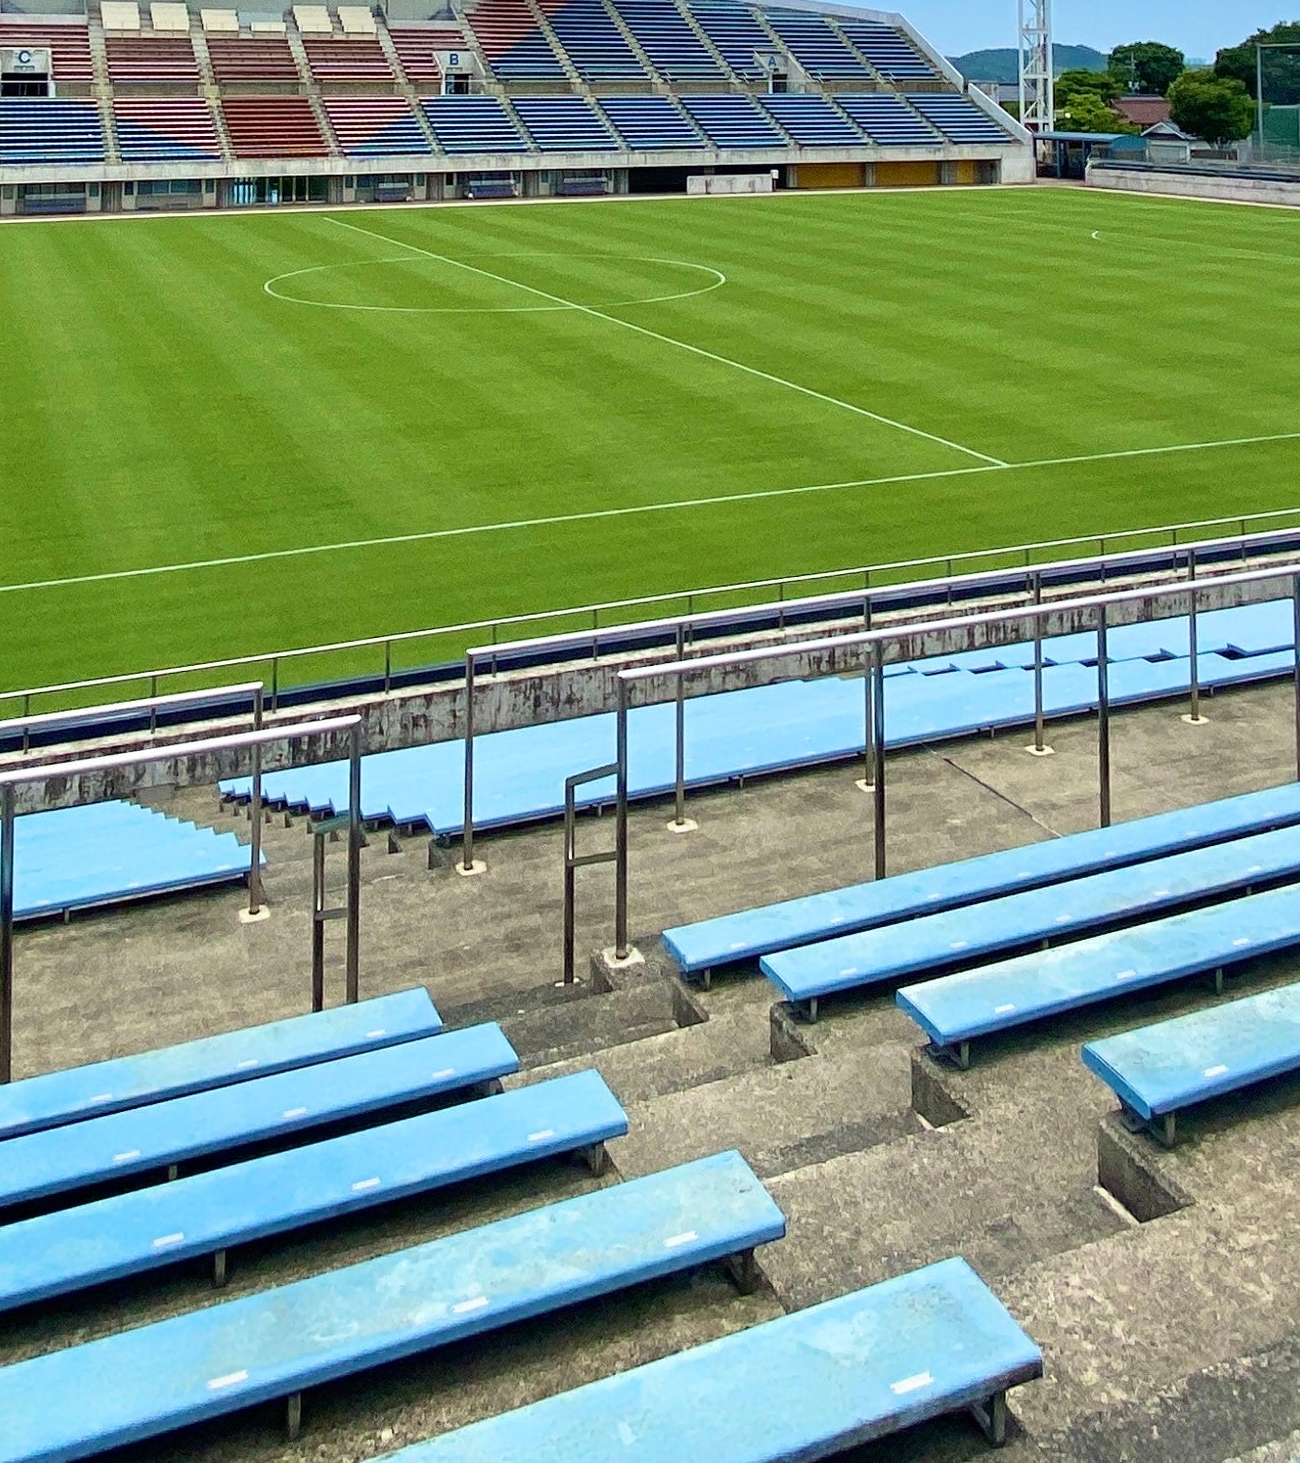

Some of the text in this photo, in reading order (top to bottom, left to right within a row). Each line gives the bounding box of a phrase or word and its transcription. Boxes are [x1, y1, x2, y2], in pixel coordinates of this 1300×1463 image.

[19, 50, 31, 64] C
[450, 53, 459, 66] B
[768, 55, 777, 66] A
